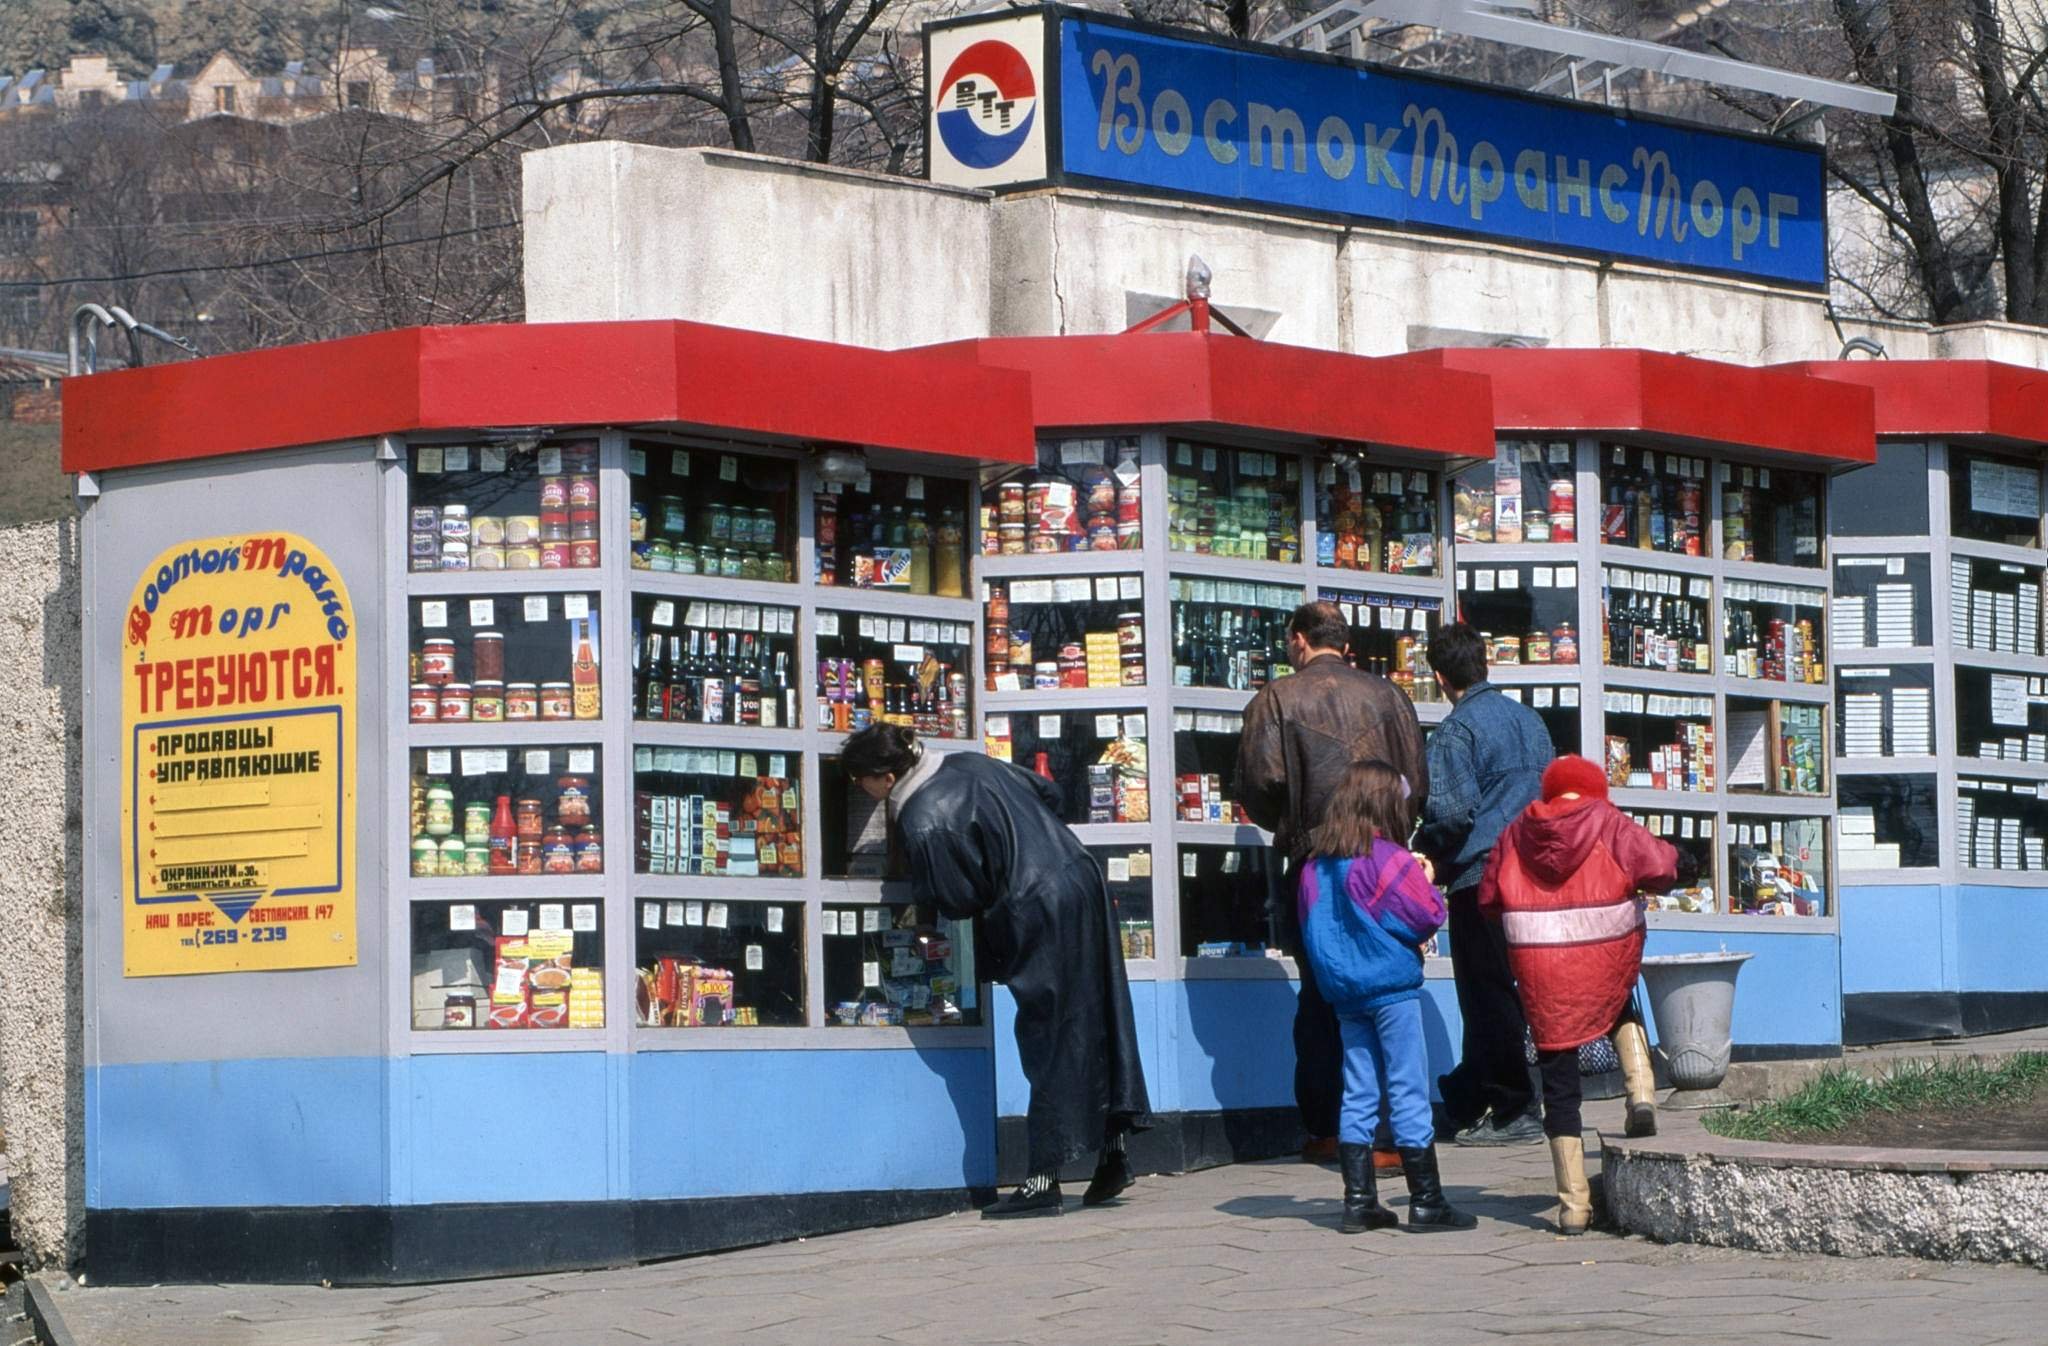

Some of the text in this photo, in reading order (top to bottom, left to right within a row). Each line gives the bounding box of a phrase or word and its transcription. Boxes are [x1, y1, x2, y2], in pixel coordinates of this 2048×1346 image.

[956, 80, 1015, 128] ВТТ
[169, 603, 291, 639] Торг
[134, 643, 344, 714] ТРЕБУЮТСЯ:
[157, 726, 274, 757] ПРОДАВЦЫ
[157, 750, 320, 783] УПРАВЛЯЮЩИЕ
[161, 863, 237, 882] ОХРАННИКИ
[145, 914, 169, 930] НАШ
[177, 910, 215, 928] АДРЕС:
[315, 903, 334, 919] 147
